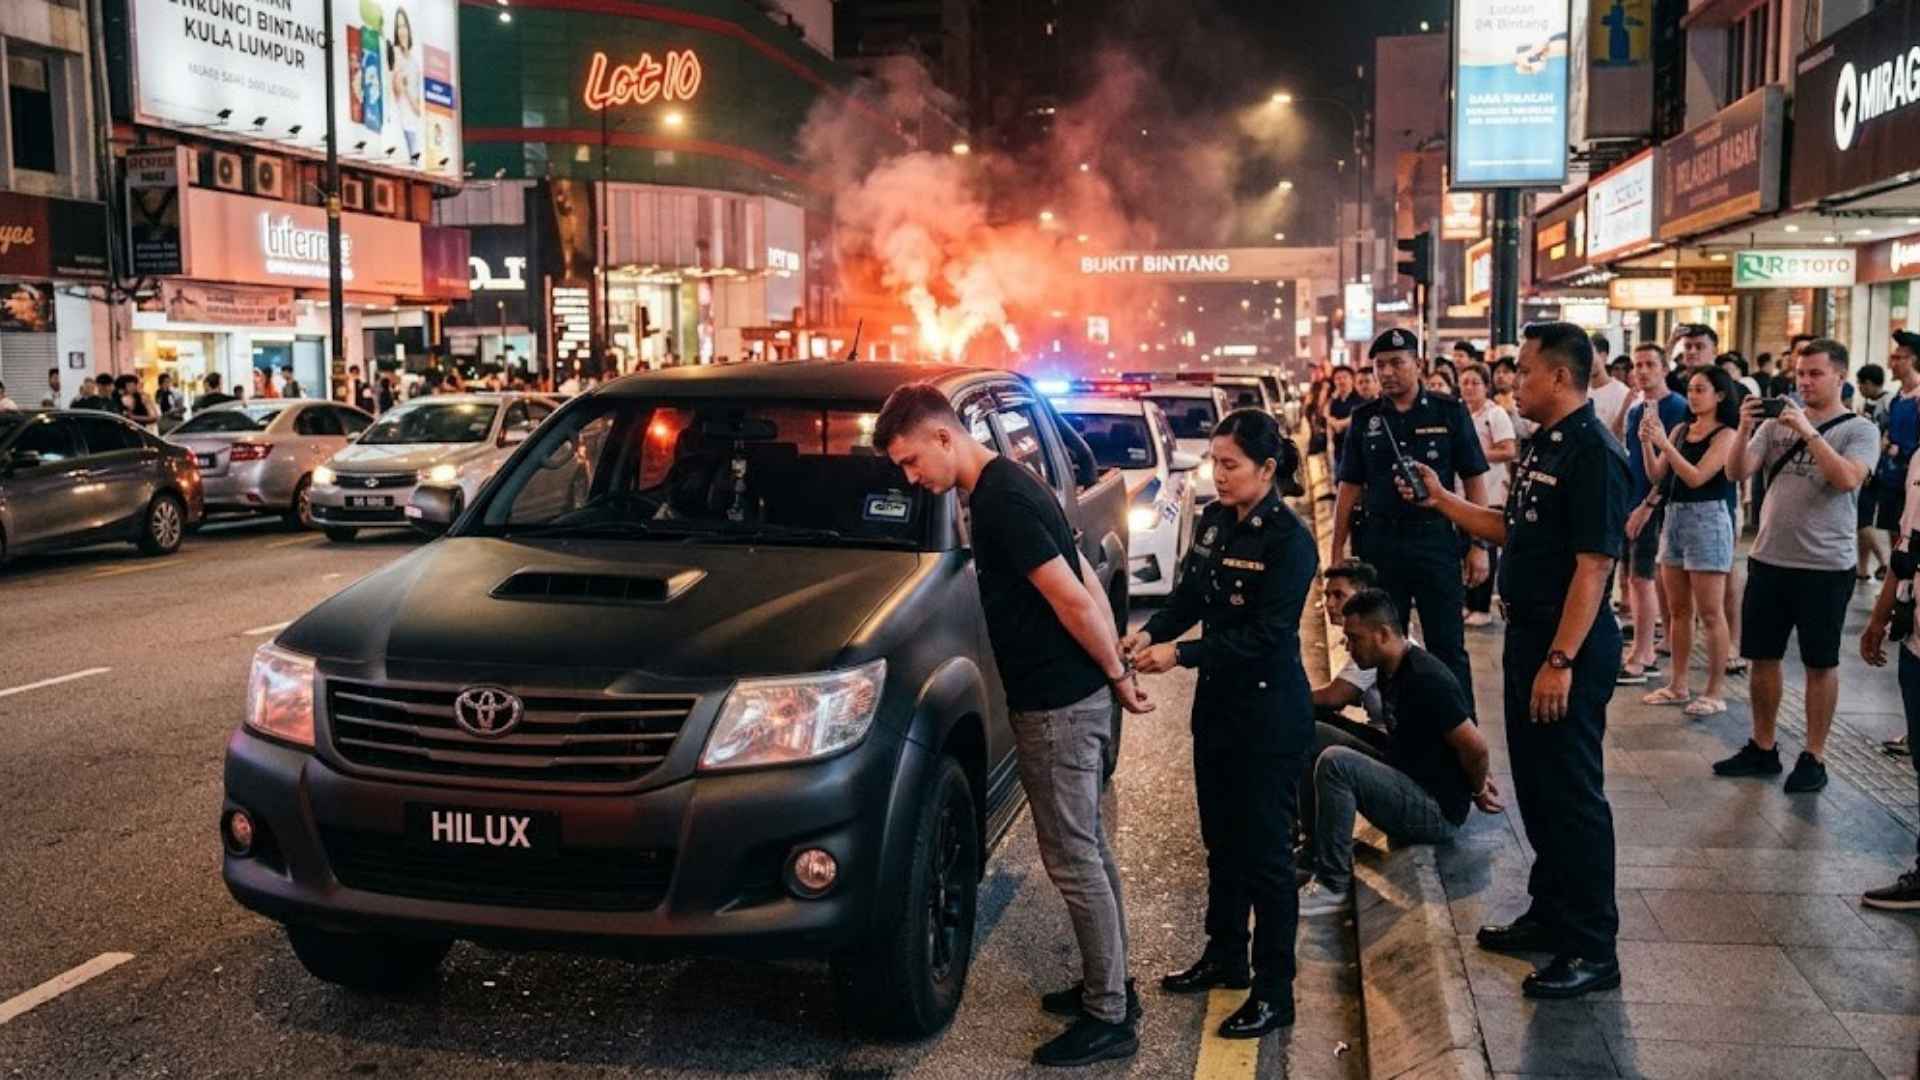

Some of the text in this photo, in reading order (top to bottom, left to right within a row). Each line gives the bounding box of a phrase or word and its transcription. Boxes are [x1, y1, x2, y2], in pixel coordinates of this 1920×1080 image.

[184, 17, 305, 70] KULA LUMPUR
[1081, 254, 1230, 273] BUKIT BINTANG
[432, 811, 531, 848] HILUX
